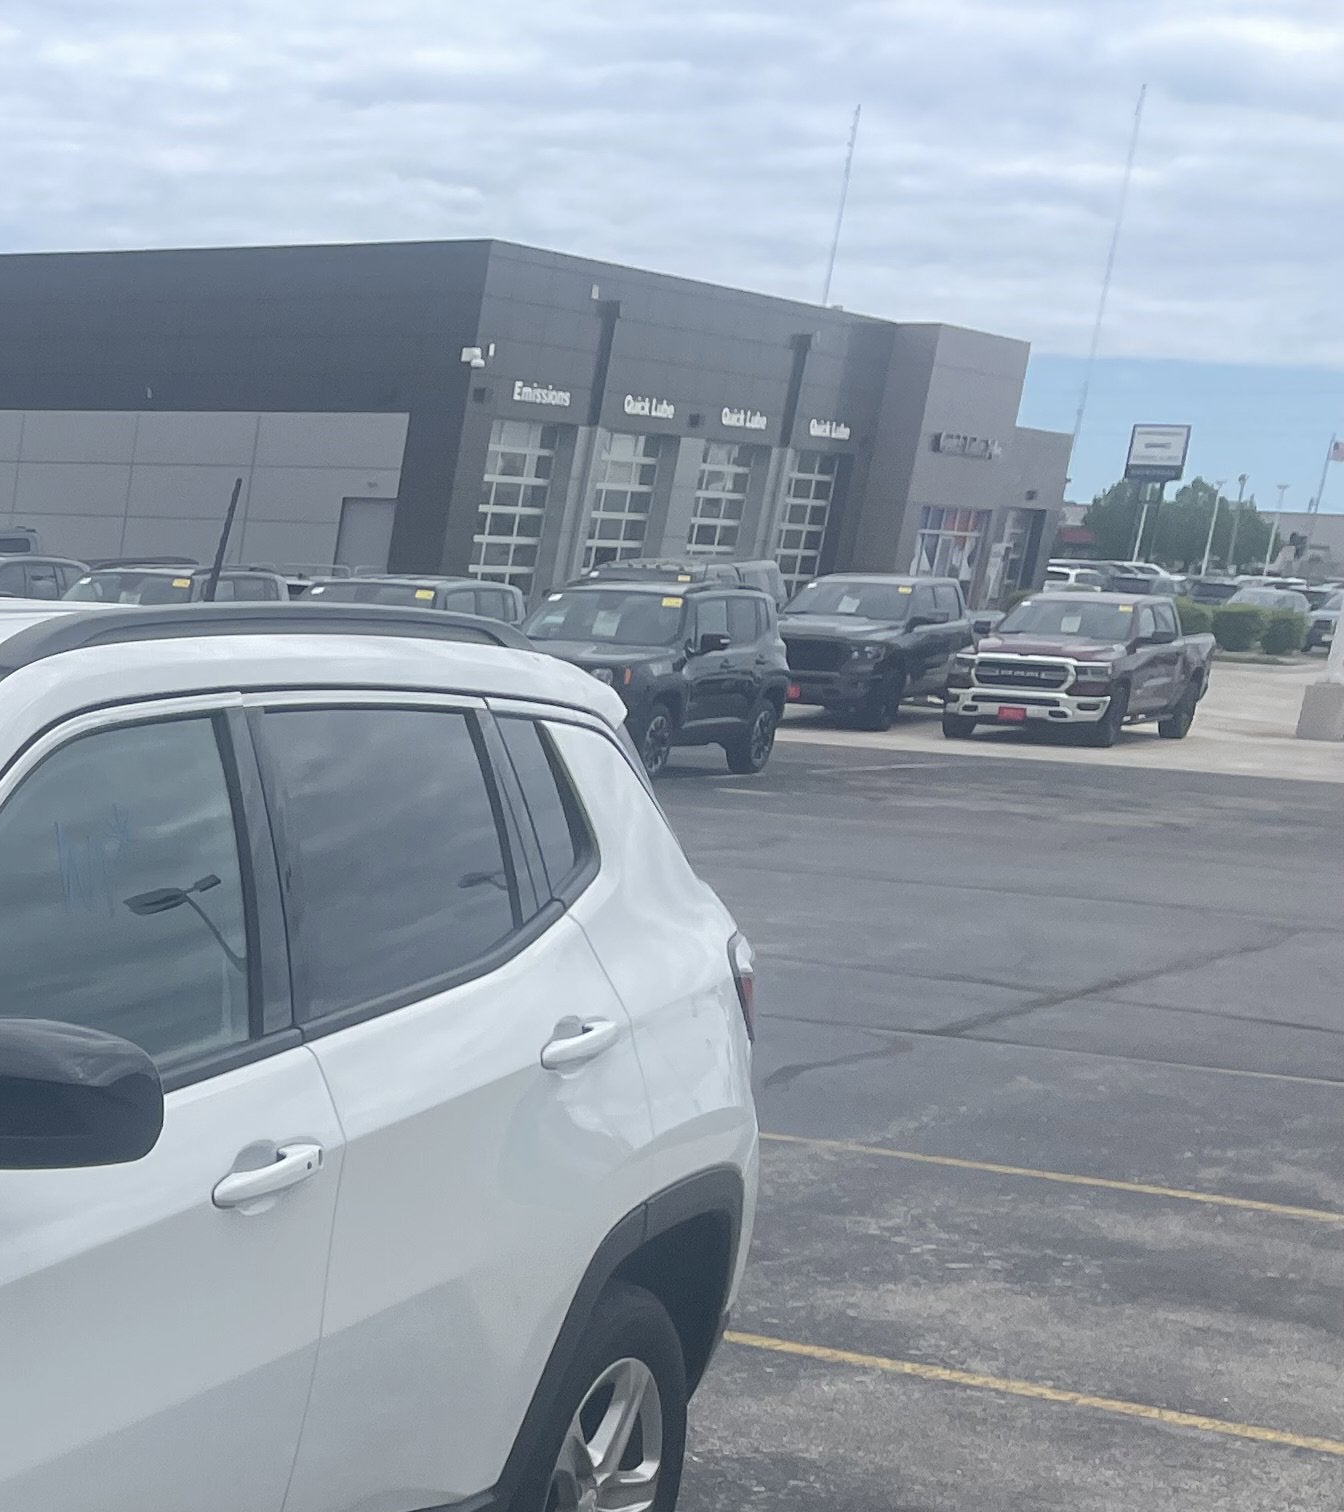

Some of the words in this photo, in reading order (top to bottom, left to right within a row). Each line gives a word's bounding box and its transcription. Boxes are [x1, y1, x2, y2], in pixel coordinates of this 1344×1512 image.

[513, 380, 571, 407] Emissions
[624, 394, 650, 416] Quick
[651, 397, 676, 419] Lube
